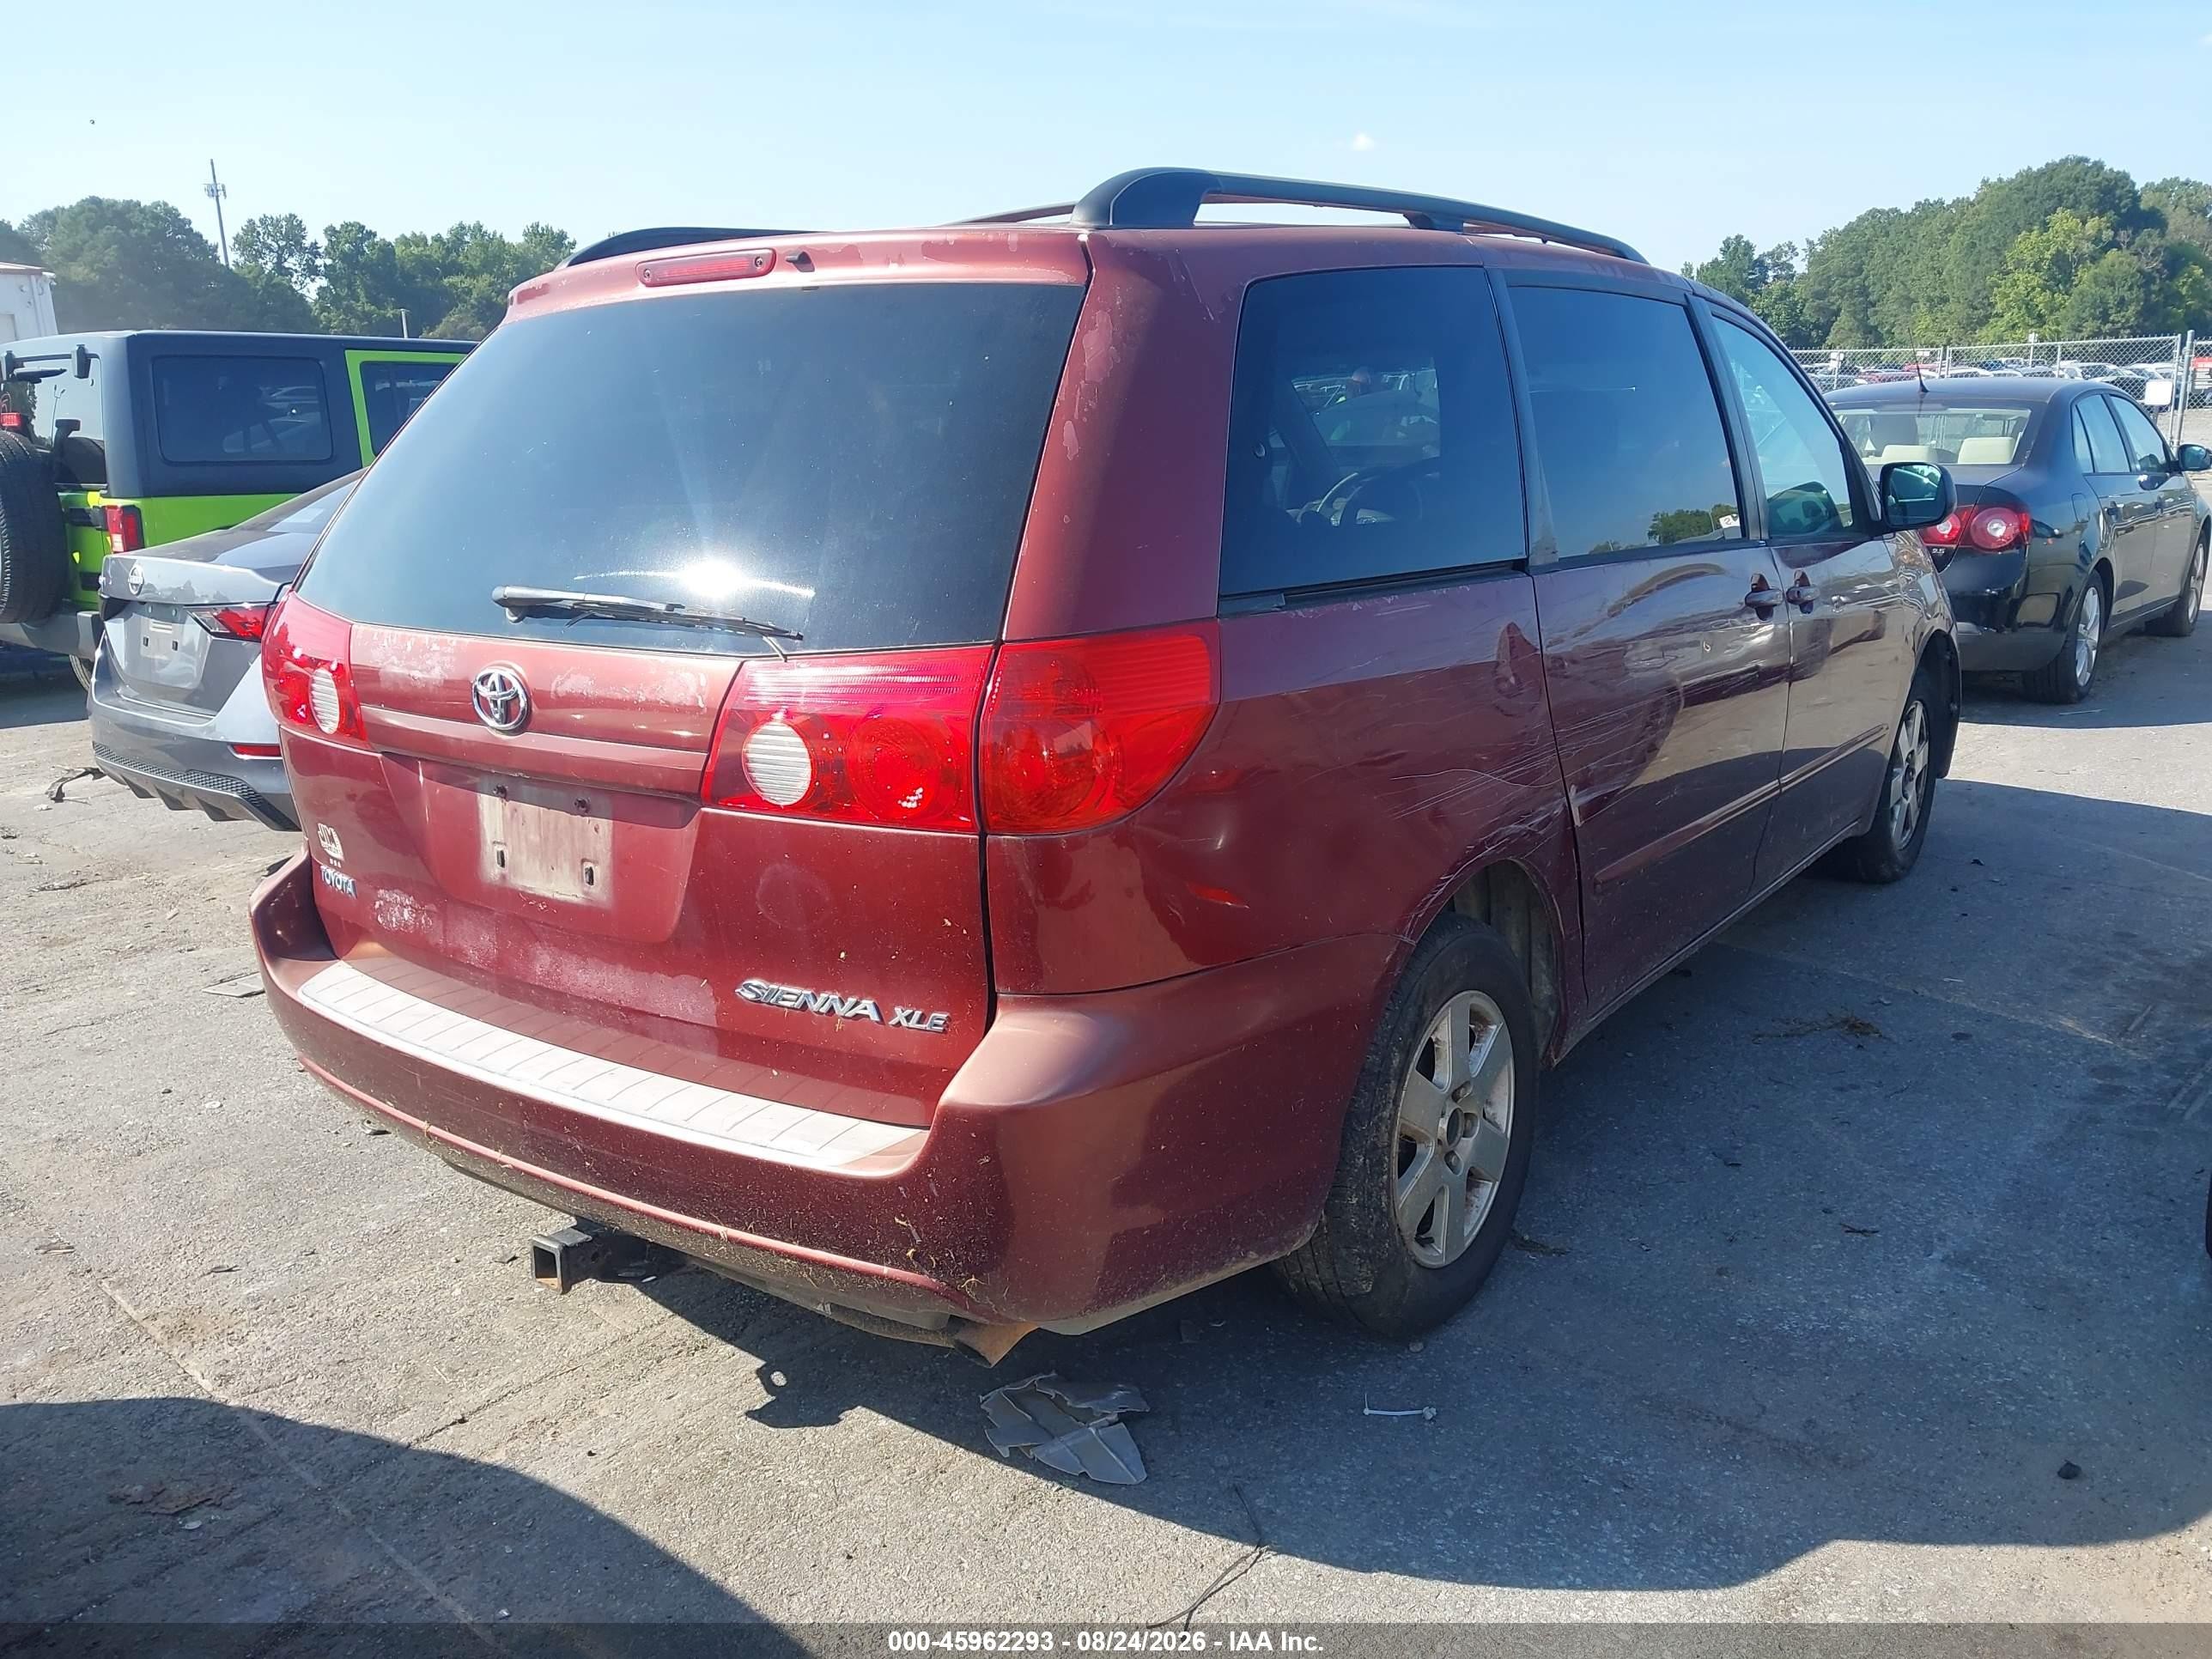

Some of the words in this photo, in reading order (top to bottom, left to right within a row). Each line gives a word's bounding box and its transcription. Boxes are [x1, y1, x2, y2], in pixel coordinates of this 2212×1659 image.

[320, 864, 357, 899] TOYOTA
[735, 979, 884, 1024] SIENNA
[888, 1006, 951, 1033] XLE
